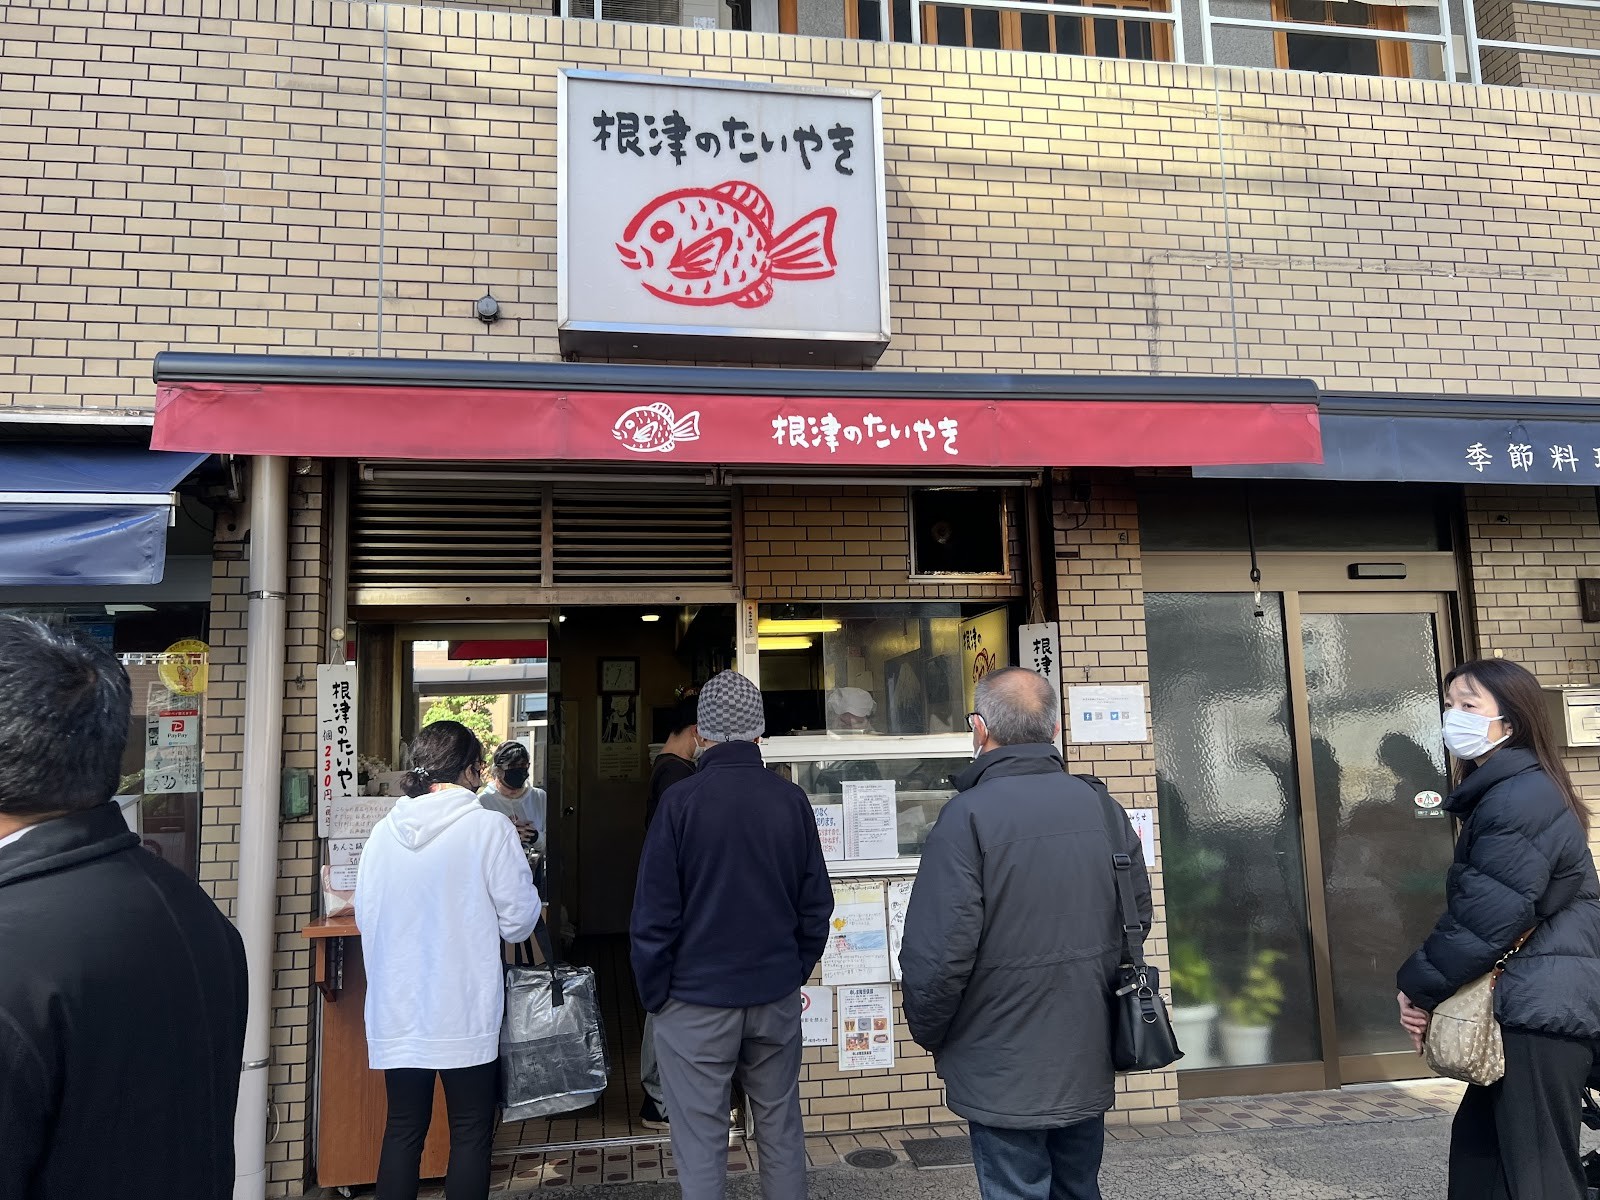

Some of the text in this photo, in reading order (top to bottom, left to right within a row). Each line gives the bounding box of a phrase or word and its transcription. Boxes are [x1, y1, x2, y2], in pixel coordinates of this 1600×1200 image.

[593, 109, 855, 176] 根津のたいやき
[771, 412, 959, 456] 根津のたいやき
[962, 626, 982, 652] 根津の
[1032, 637, 1053, 677] 根津
[332, 681, 354, 797] 根津のたいや
